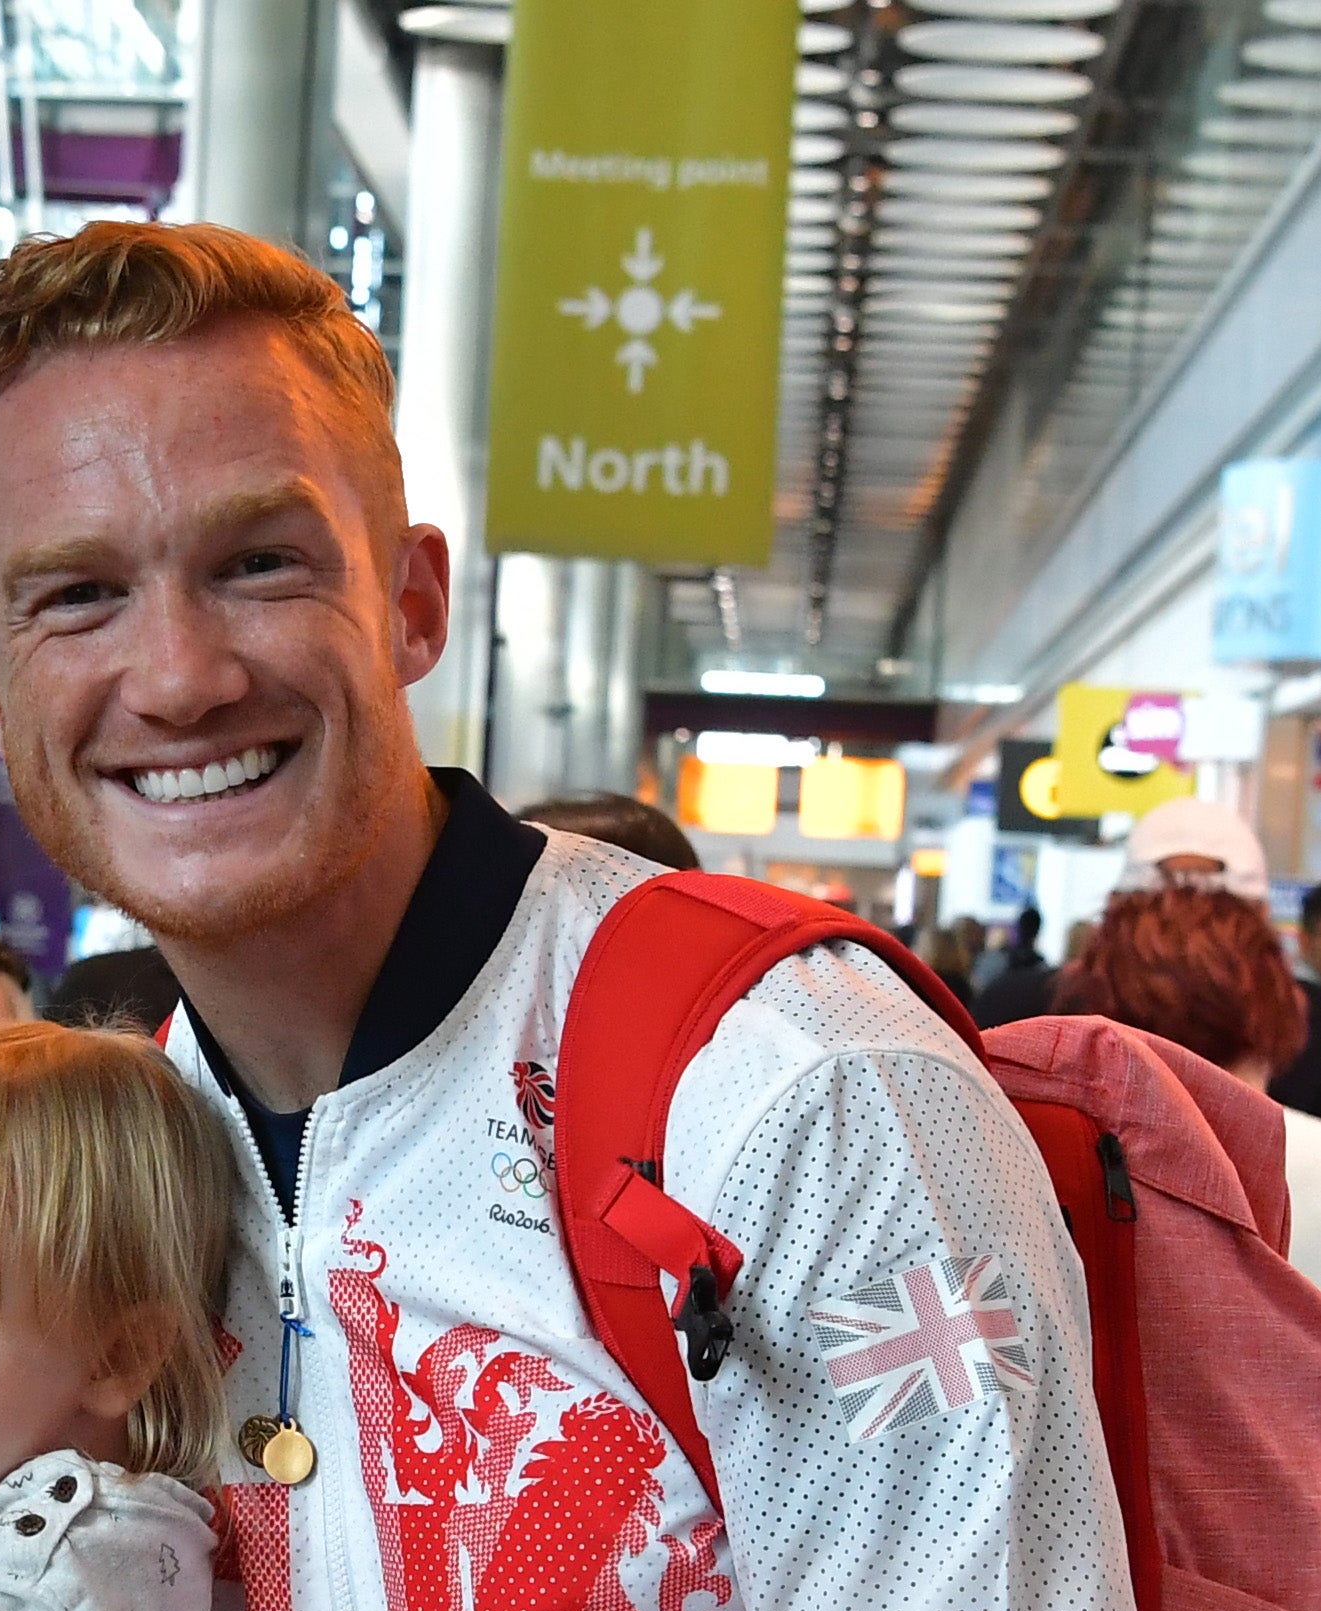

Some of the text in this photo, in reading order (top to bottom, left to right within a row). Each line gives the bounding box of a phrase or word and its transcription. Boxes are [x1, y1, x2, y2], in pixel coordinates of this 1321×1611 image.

[532, 149, 768, 191] Meeting point
[537, 434, 729, 497] North
[487, 1118, 537, 1151] TEAM
